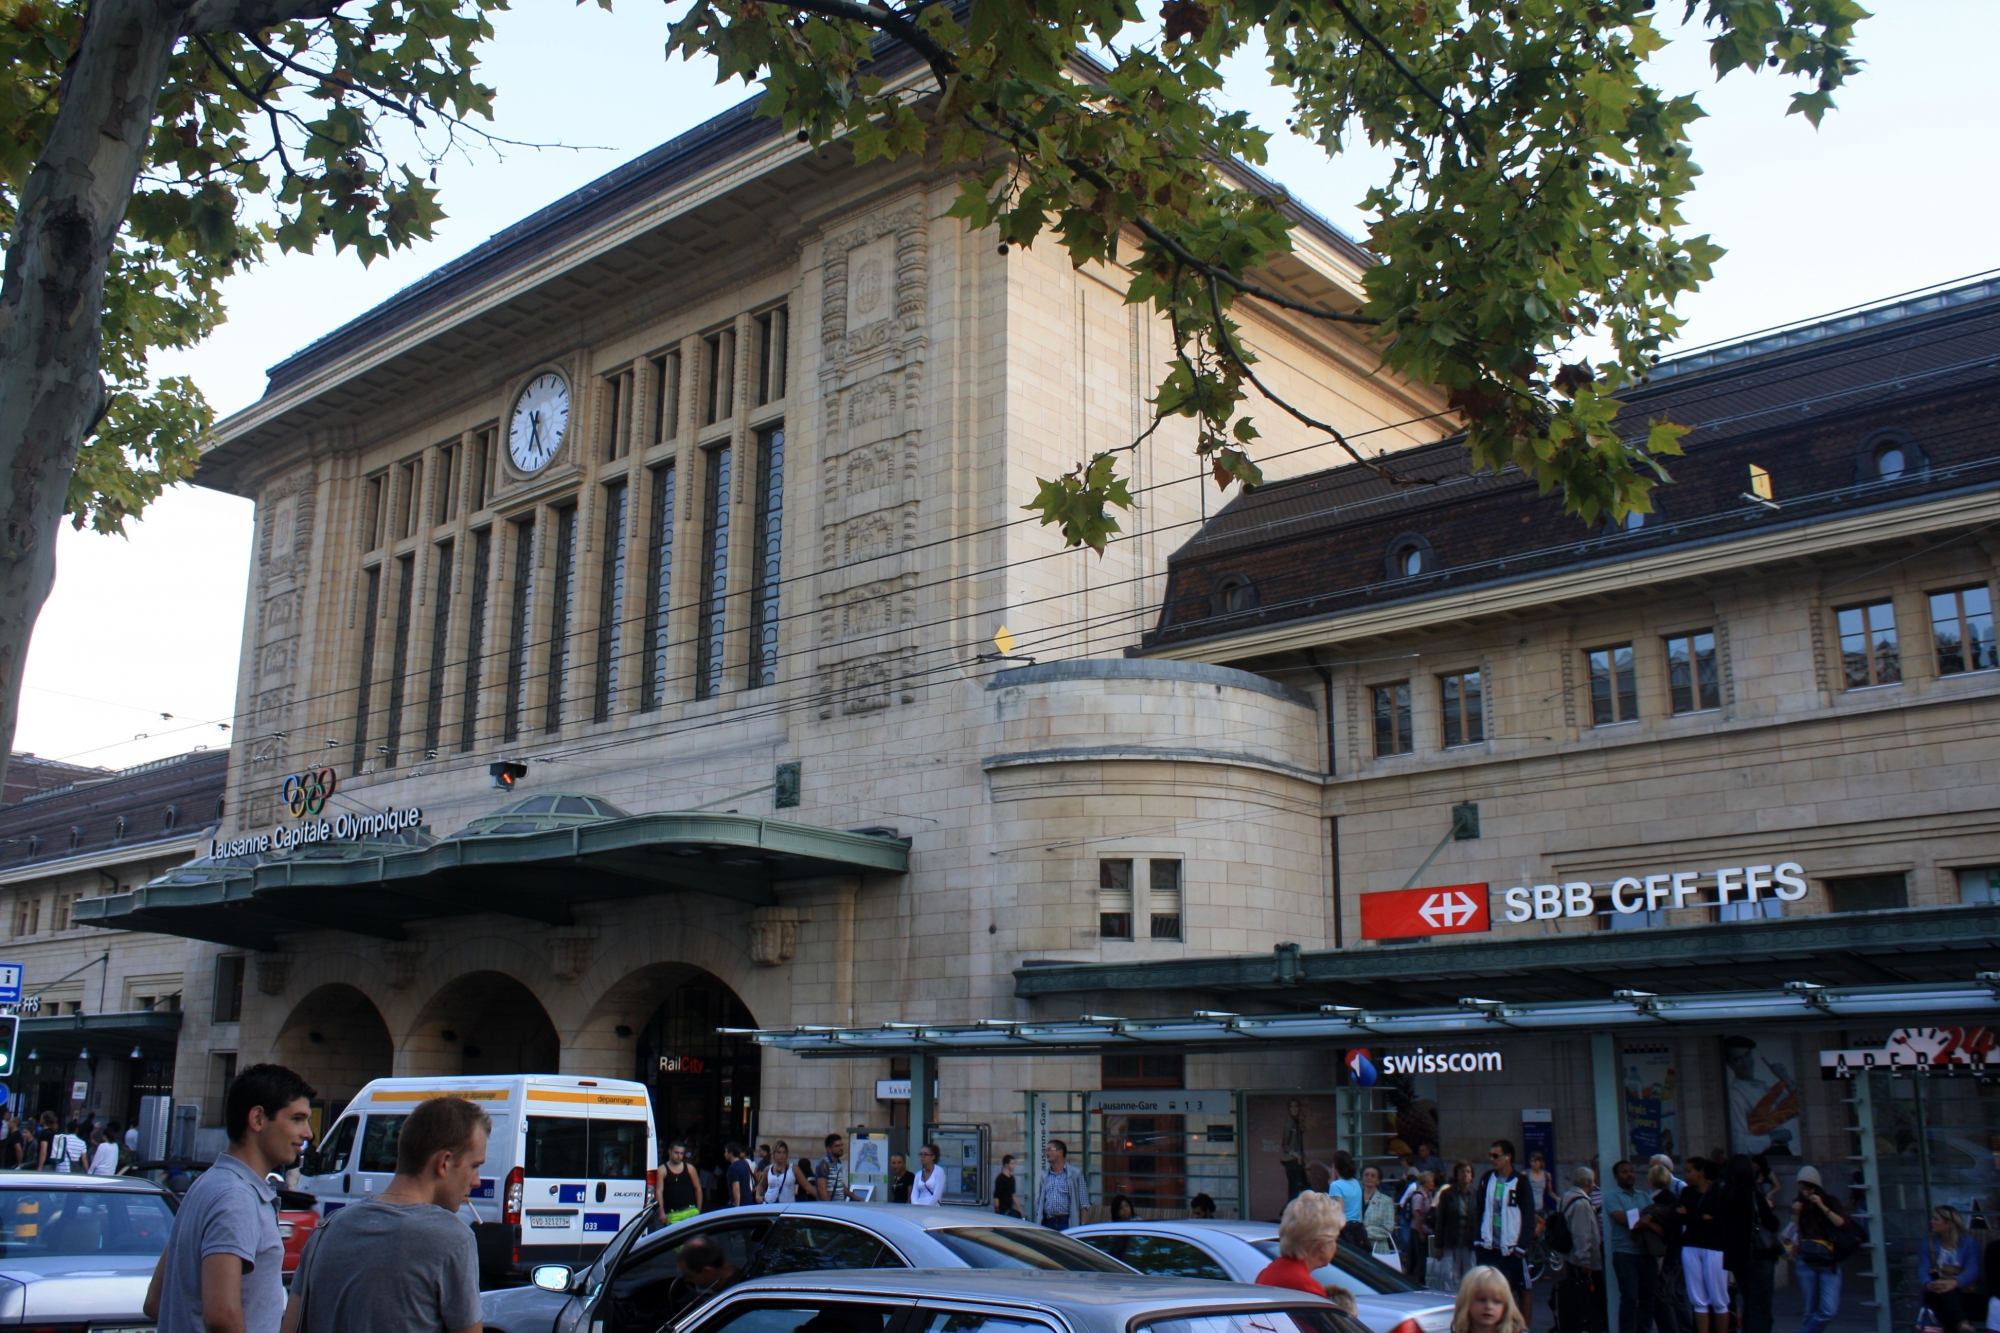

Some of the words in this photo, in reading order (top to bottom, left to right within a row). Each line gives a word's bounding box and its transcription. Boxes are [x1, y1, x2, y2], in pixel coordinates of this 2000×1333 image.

[209, 834, 269, 860] Lausanne
[274, 819, 330, 850] Capitale
[336, 807, 421, 841] Olympique
[1505, 882, 1595, 922] SBB
[1611, 871, 1699, 914] CFF
[1716, 862, 1808, 904] FFS
[23, 996, 39, 1012] FFS
[1932, 1026, 1996, 1065] 24
[660, 1056, 704, 1074] RailCity
[1383, 1047, 1503, 1075] swisscom
[1836, 1051, 1985, 1078] APERTO
[889, 1086, 911, 1094] Lausa
[1098, 1101, 1158, 1110] Lausanne-Gare
[1185, 1101, 1189, 1110] 1
[1197, 1101, 1202, 1110] 3
[484, 1188, 494, 1197] 033
[576, 1191, 585, 1202] tl
[584, 1222, 598, 1230] 033
